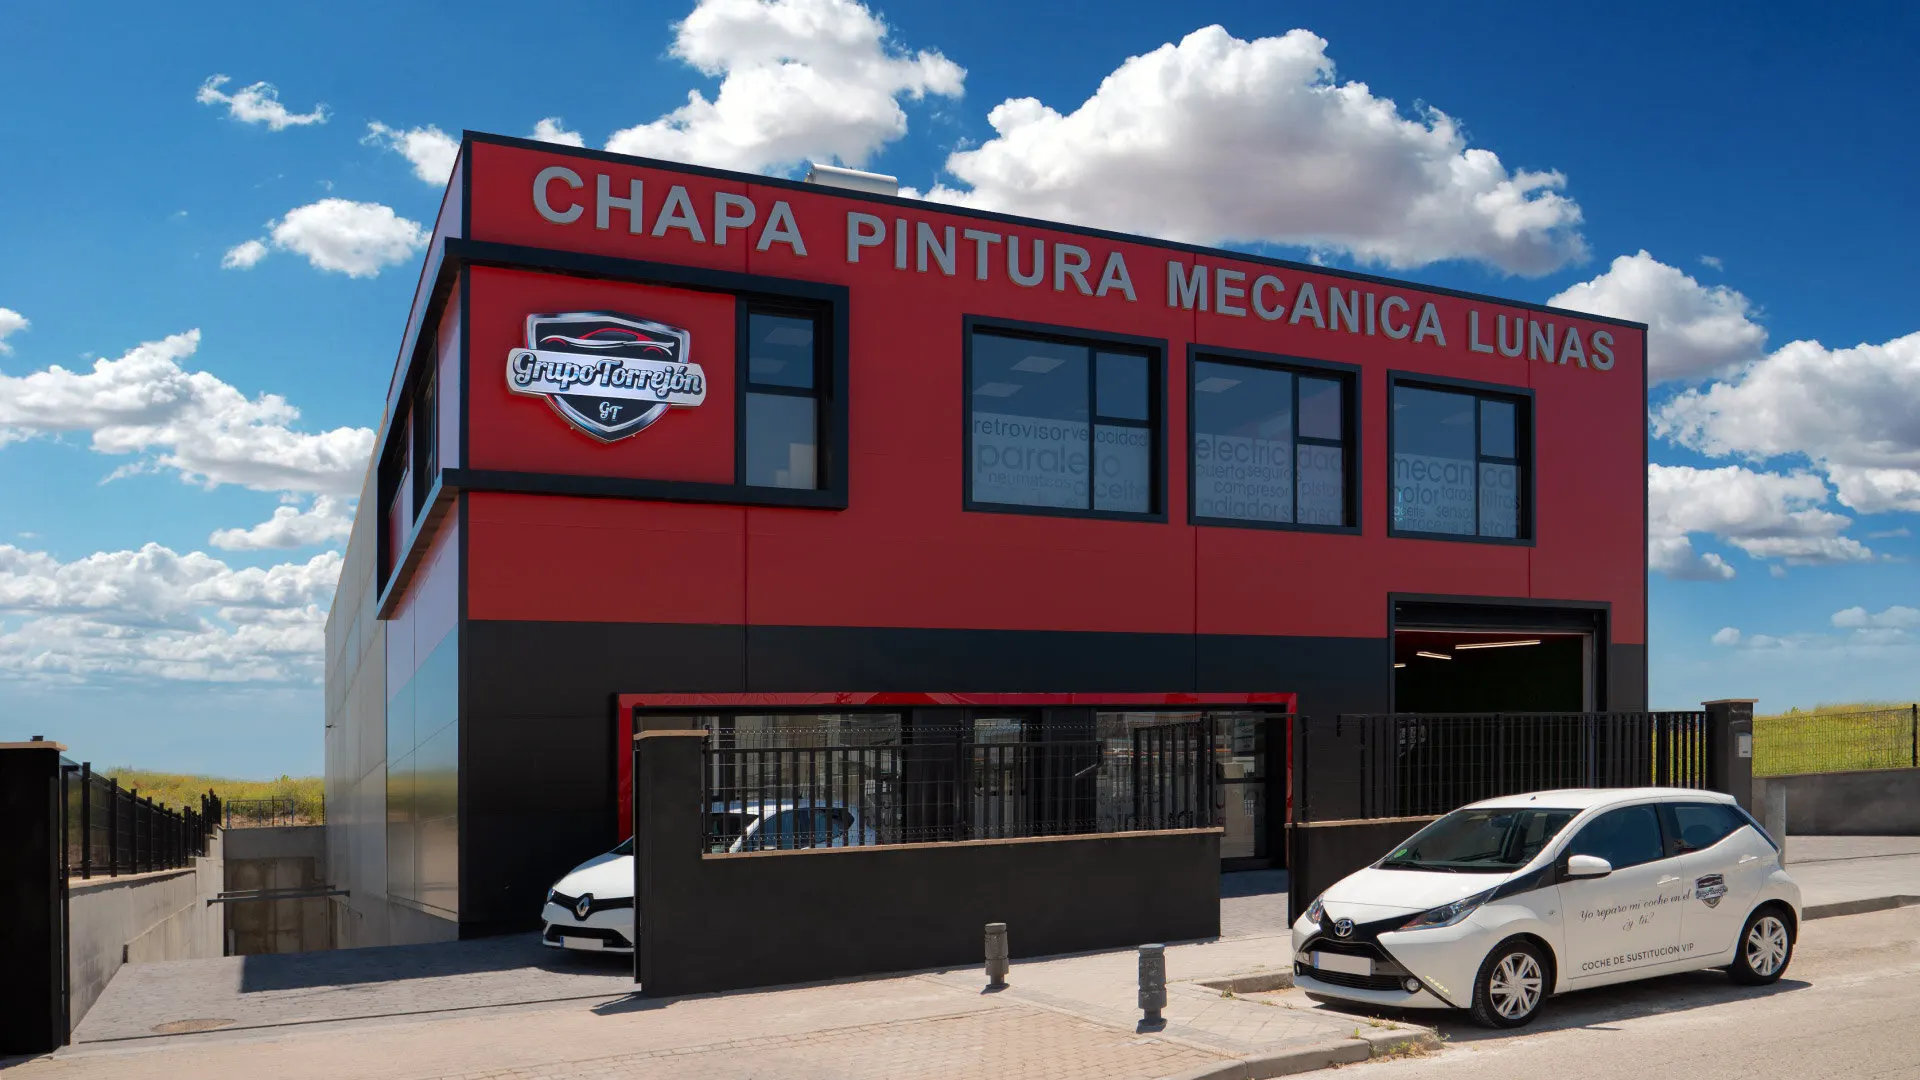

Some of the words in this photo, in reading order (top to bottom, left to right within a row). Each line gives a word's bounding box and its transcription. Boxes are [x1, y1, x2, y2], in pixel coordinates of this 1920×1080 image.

[532, 166, 807, 256] CHAPA
[847, 211, 1138, 301] PINTURA
[1166, 261, 1447, 346] MECANICA
[1469, 310, 1616, 371] LUNAS
[599, 402, 623, 420] GT
[974, 418, 1069, 442] retrovisor
[1213, 480, 1292, 501] compresor
[1580, 910, 1594, 922] Yo
[1597, 903, 1627, 920] reparo
[1629, 899, 1641, 910] mi
[1643, 893, 1668, 908] coche
[1670, 895, 1681, 903] en
[1682, 888, 1692, 900] el
[1581, 957, 1612, 971] COCHE
[1613, 955, 1625, 964] DE
[1627, 944, 1680, 963] SUSTITUCIÓN
[1681, 942, 1695, 953] VIP
